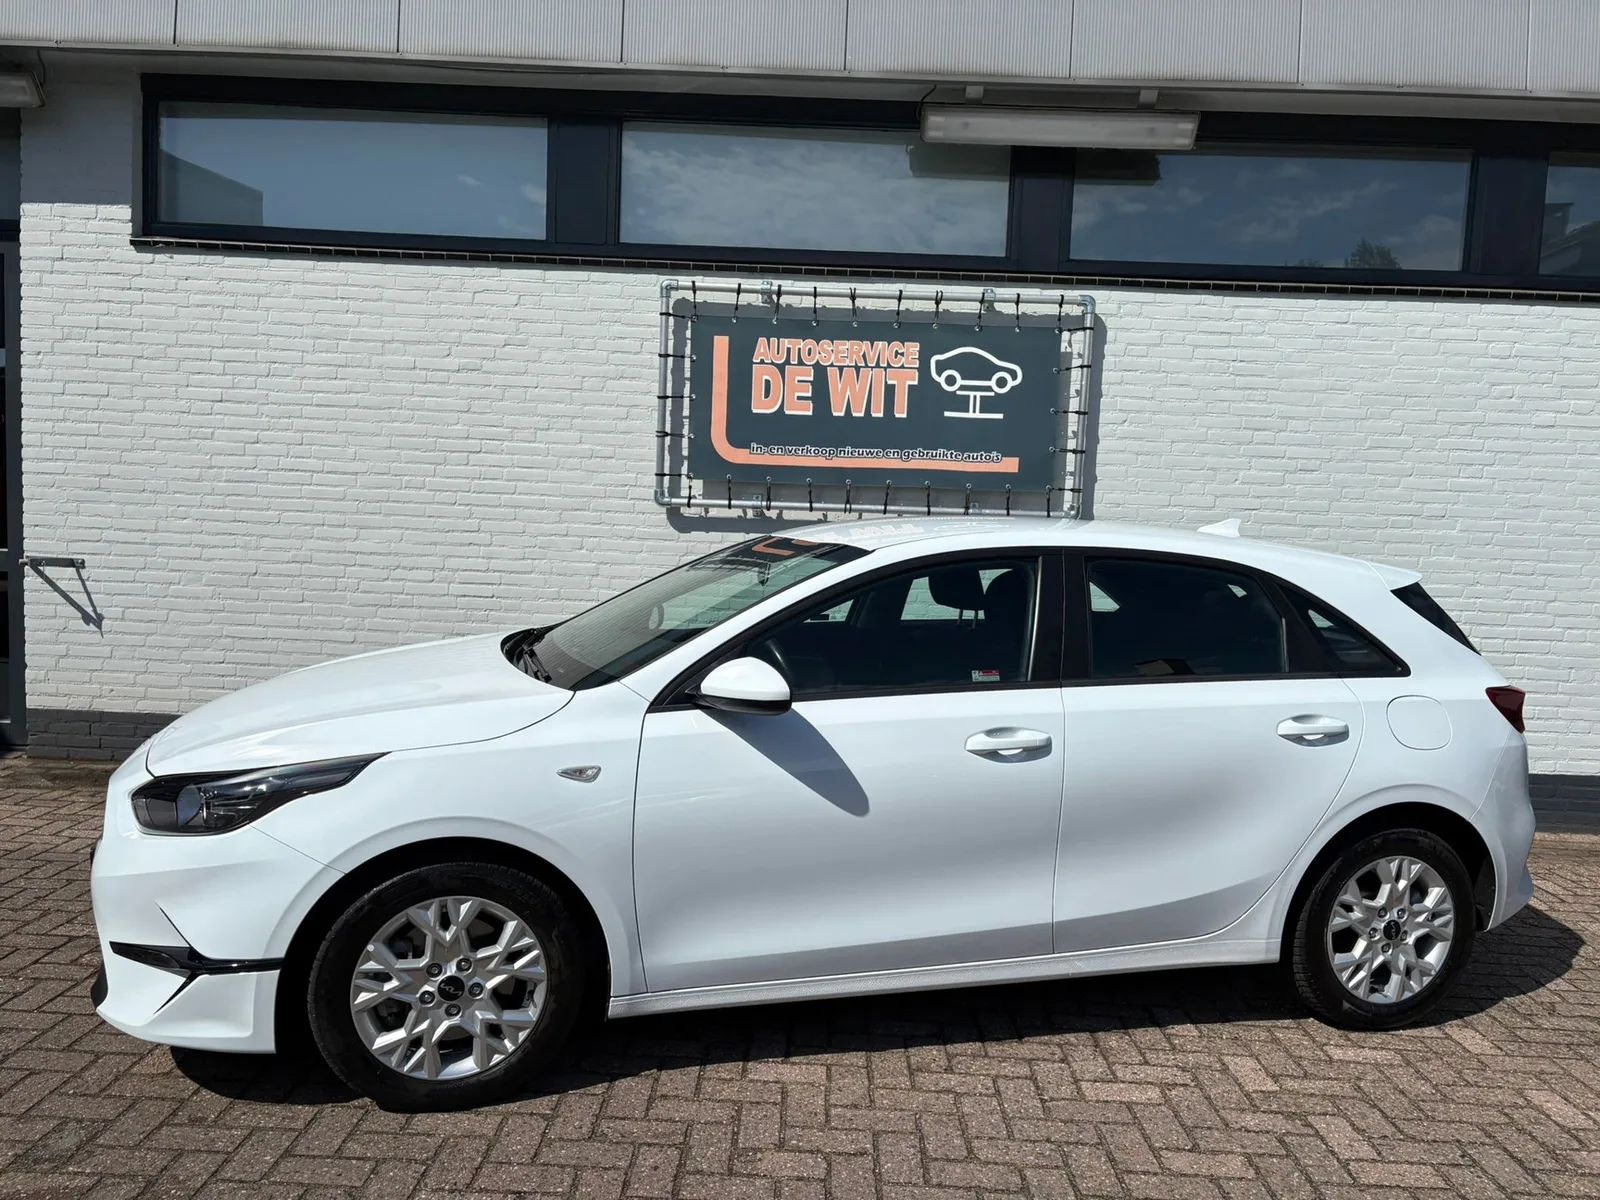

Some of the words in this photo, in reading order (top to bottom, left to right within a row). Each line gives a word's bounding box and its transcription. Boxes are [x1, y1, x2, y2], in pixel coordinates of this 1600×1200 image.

[752, 337, 920, 368] AUTOSERVICE
[751, 364, 814, 416] DE
[827, 367, 919, 418] WIT
[768, 445, 785, 455] en
[786, 445, 836, 460] verkoop
[838, 446, 883, 458] nieuwe
[884, 448, 901, 459] en
[902, 448, 962, 462] gebruikte
[963, 451, 1002, 463] auto's
